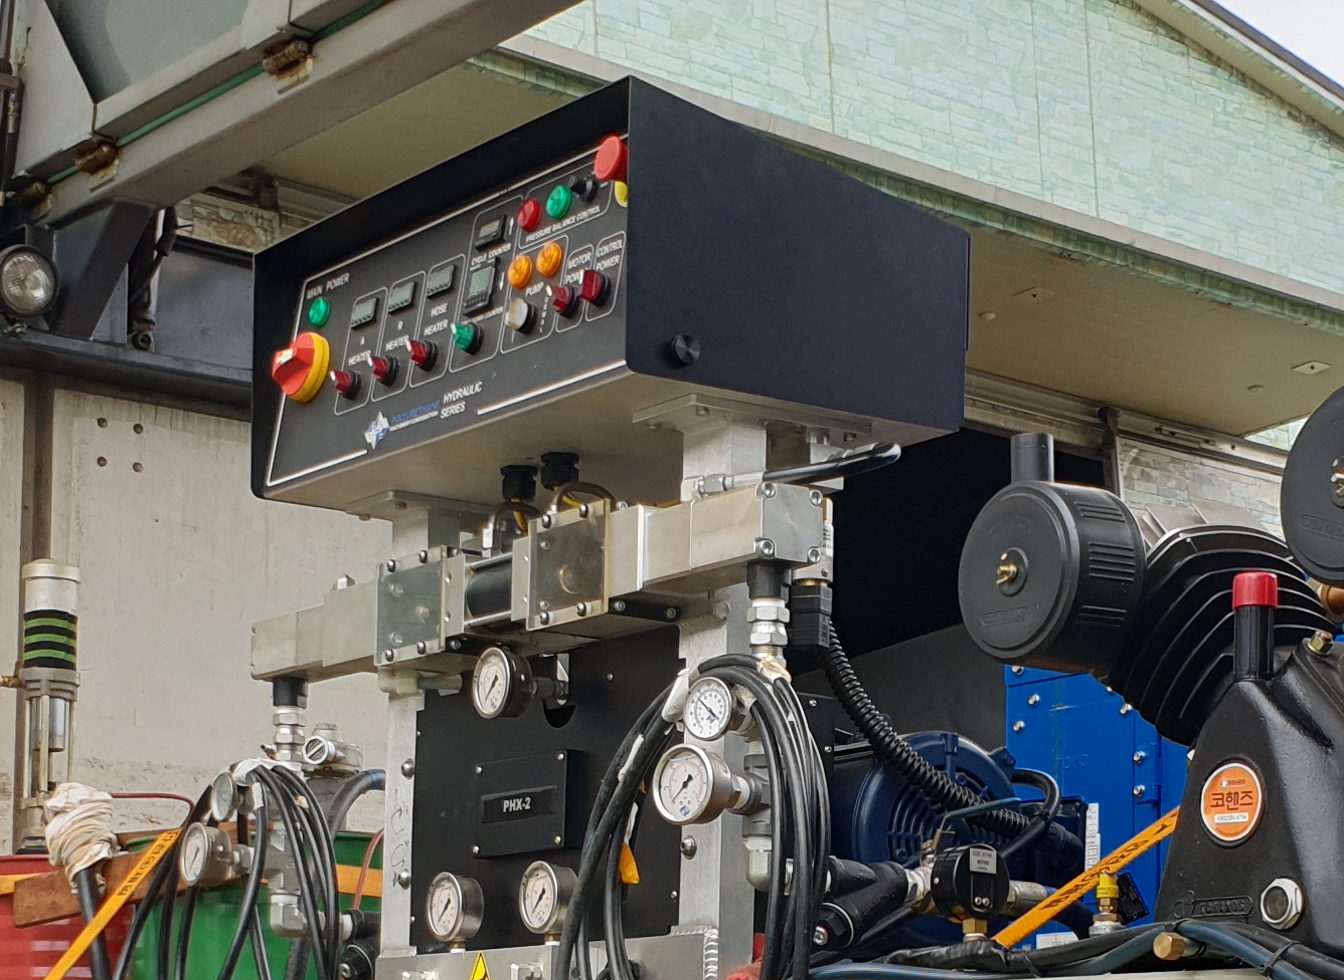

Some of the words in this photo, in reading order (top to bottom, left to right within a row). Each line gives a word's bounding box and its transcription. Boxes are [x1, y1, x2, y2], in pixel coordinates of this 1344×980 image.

[568, 252, 592, 269] MOTOR
[596, 255, 620, 271] POWER
[326, 273, 350, 291] POWER
[525, 282, 545, 297] PUMP
[424, 320, 449, 336] HEATER
[443, 381, 483, 403] HYDRAULIC
[440, 401, 467, 419] SERIES
[503, 797, 531, 813] PHX-2
